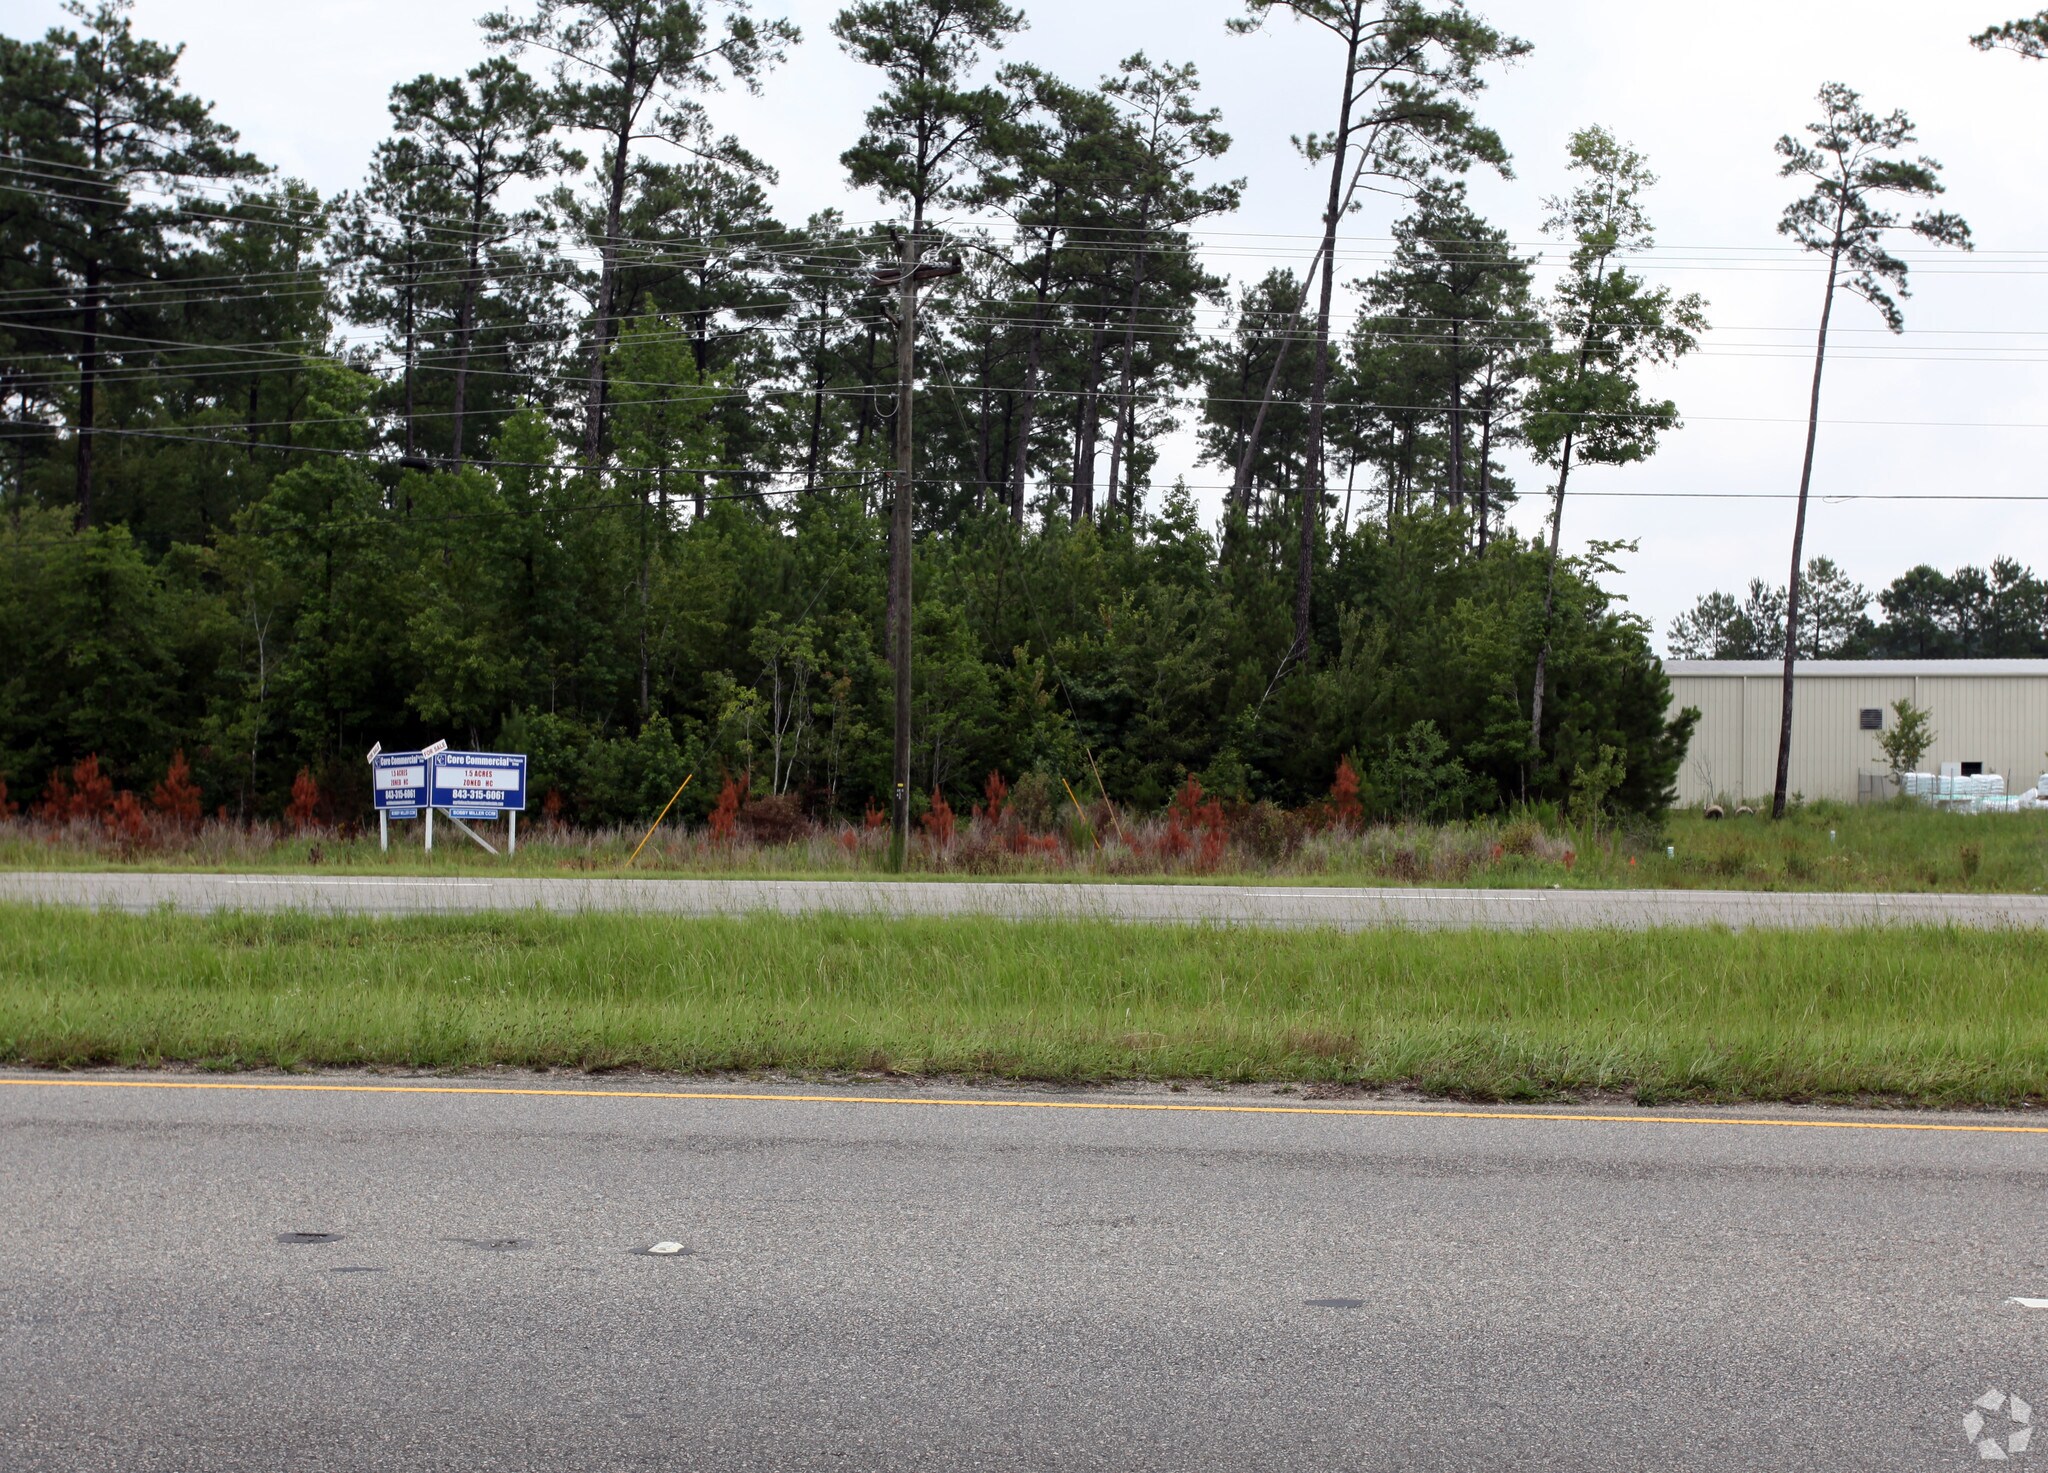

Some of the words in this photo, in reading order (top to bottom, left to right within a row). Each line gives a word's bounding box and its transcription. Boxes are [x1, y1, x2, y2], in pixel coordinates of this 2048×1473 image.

[424, 748, 434, 758] FOR
[434, 742, 446, 753] SALE
[380, 756, 391, 766] Core
[391, 755, 418, 766] Commercial
[447, 755, 465, 765] Core
[465, 755, 509, 766] Commercial
[463, 779, 481, 787] ZONED
[385, 789, 416, 800] 843-315-6061
[452, 789, 505, 800] 843-315-6061
